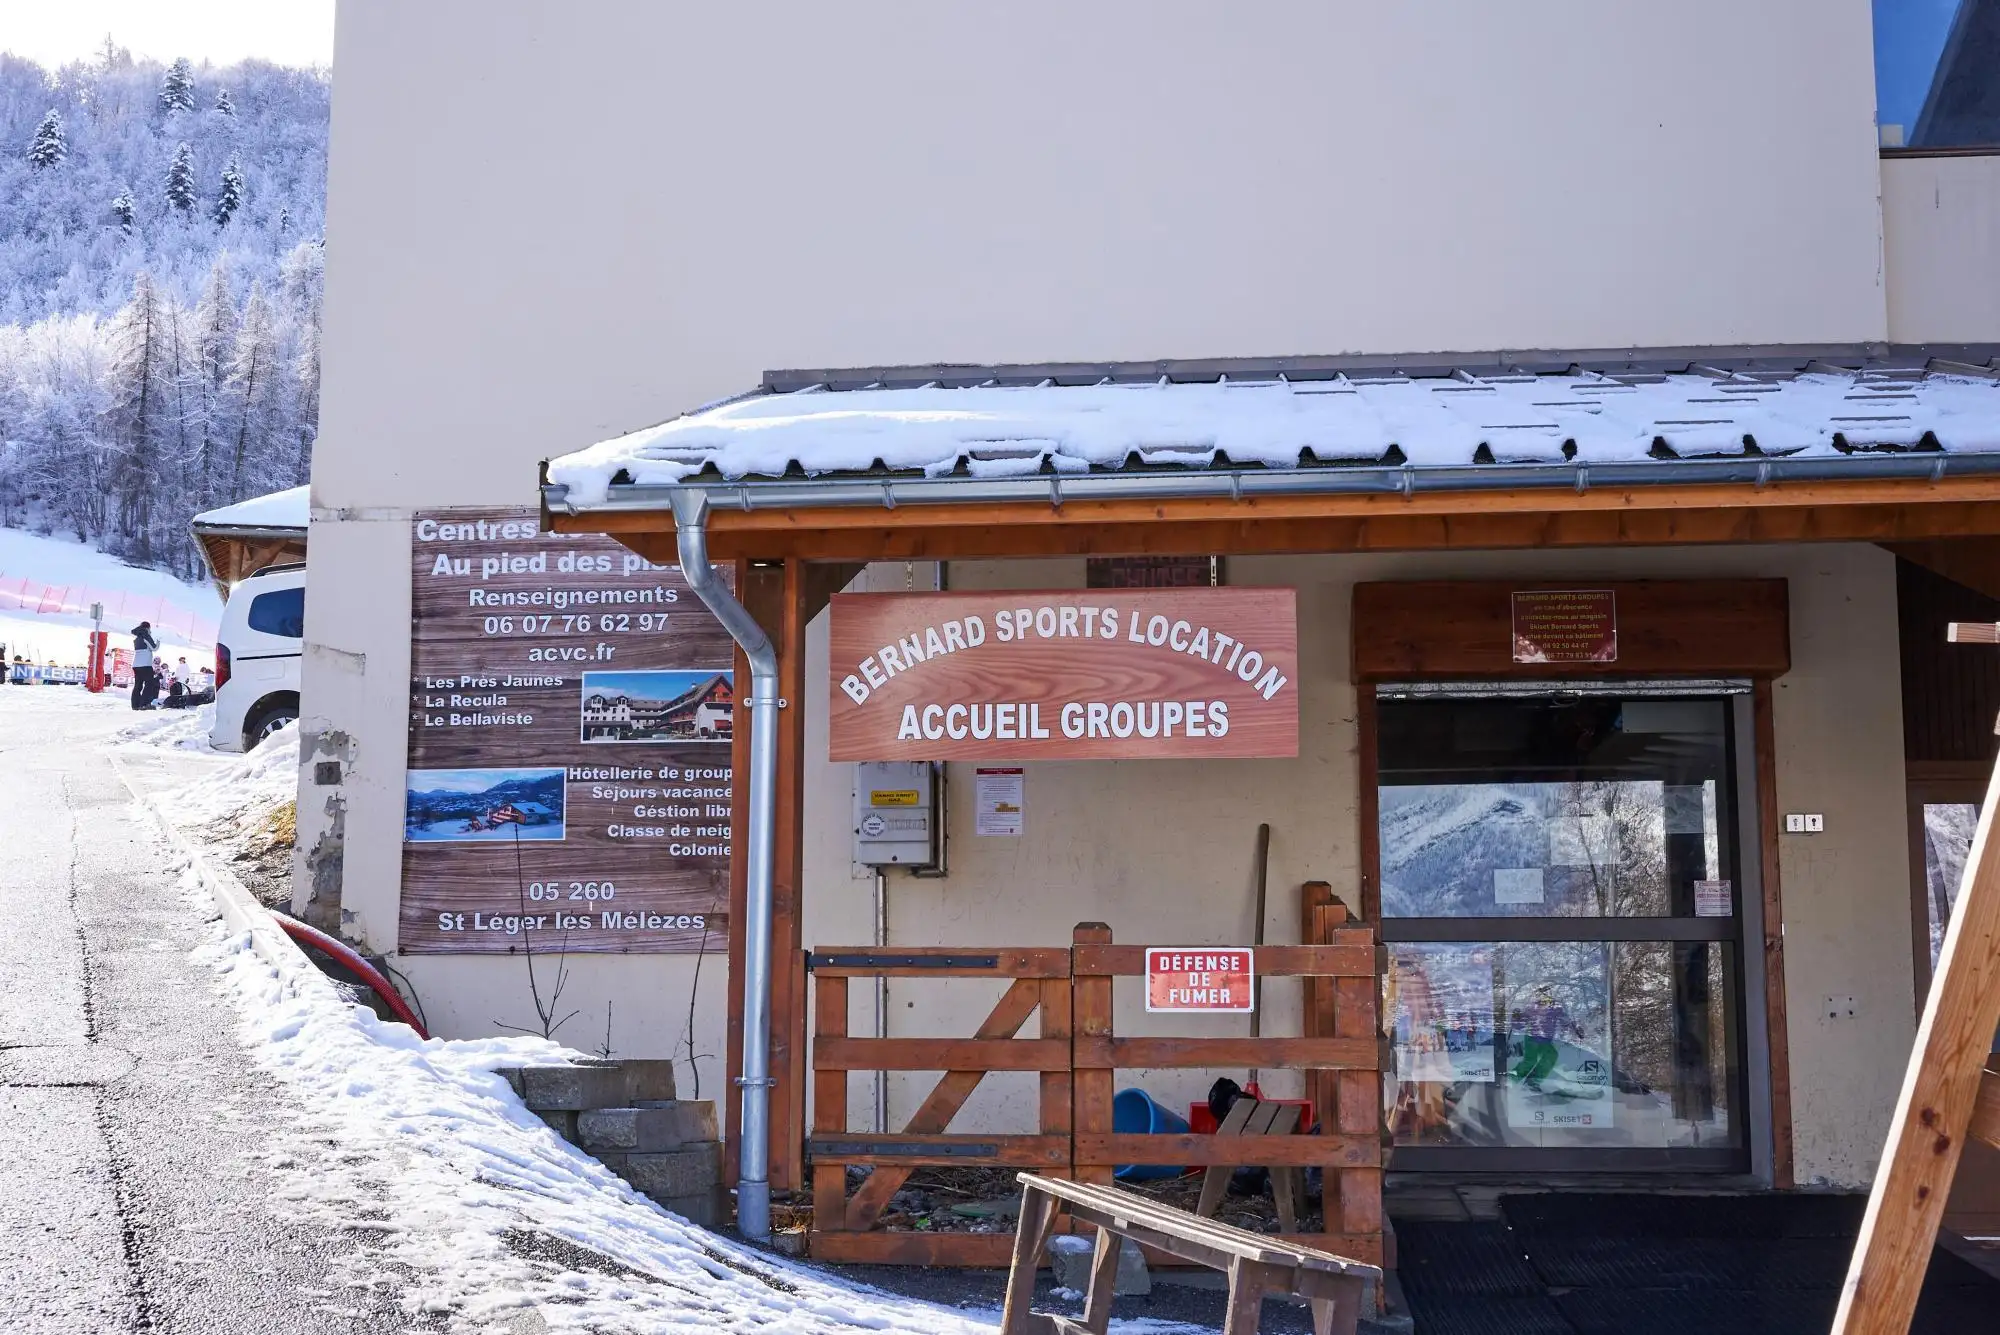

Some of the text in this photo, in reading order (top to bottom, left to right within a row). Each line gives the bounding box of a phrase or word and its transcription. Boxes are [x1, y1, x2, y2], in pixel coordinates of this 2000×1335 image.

[416, 519, 537, 541] Centres
[431, 554, 470, 575] Au
[482, 552, 546, 579] pied
[557, 551, 612, 573] des
[469, 586, 678, 608] Renseignements
[484, 613, 669, 635] 06 07 76 62 97
[528, 643, 615, 662] acvc.fr
[840, 606, 1288, 706] BERNARD SPORTS LOCATION
[426, 677, 455, 689] Les
[502, 674, 563, 687] Jaunes
[425, 693, 508, 708] La Recula
[425, 712, 533, 727] Le Bellaviste
[897, 701, 1230, 740] ACCUEIL GROUPES
[569, 766, 653, 780] Hôtellerie
[658, 766, 679, 779] de
[633, 805, 700, 817] Géstion
[607, 824, 665, 837] Classe
[670, 824, 691, 836] de
[529, 882, 616, 900] 05 260
[438, 910, 705, 934] St Léger les Mélèzes
[1160, 955, 1240, 970] DÉFENSE
[1189, 972, 1211, 987] DE
[1169, 988, 1231, 1004] FUMER
[1553, 1115, 1581, 1123] SKISET
